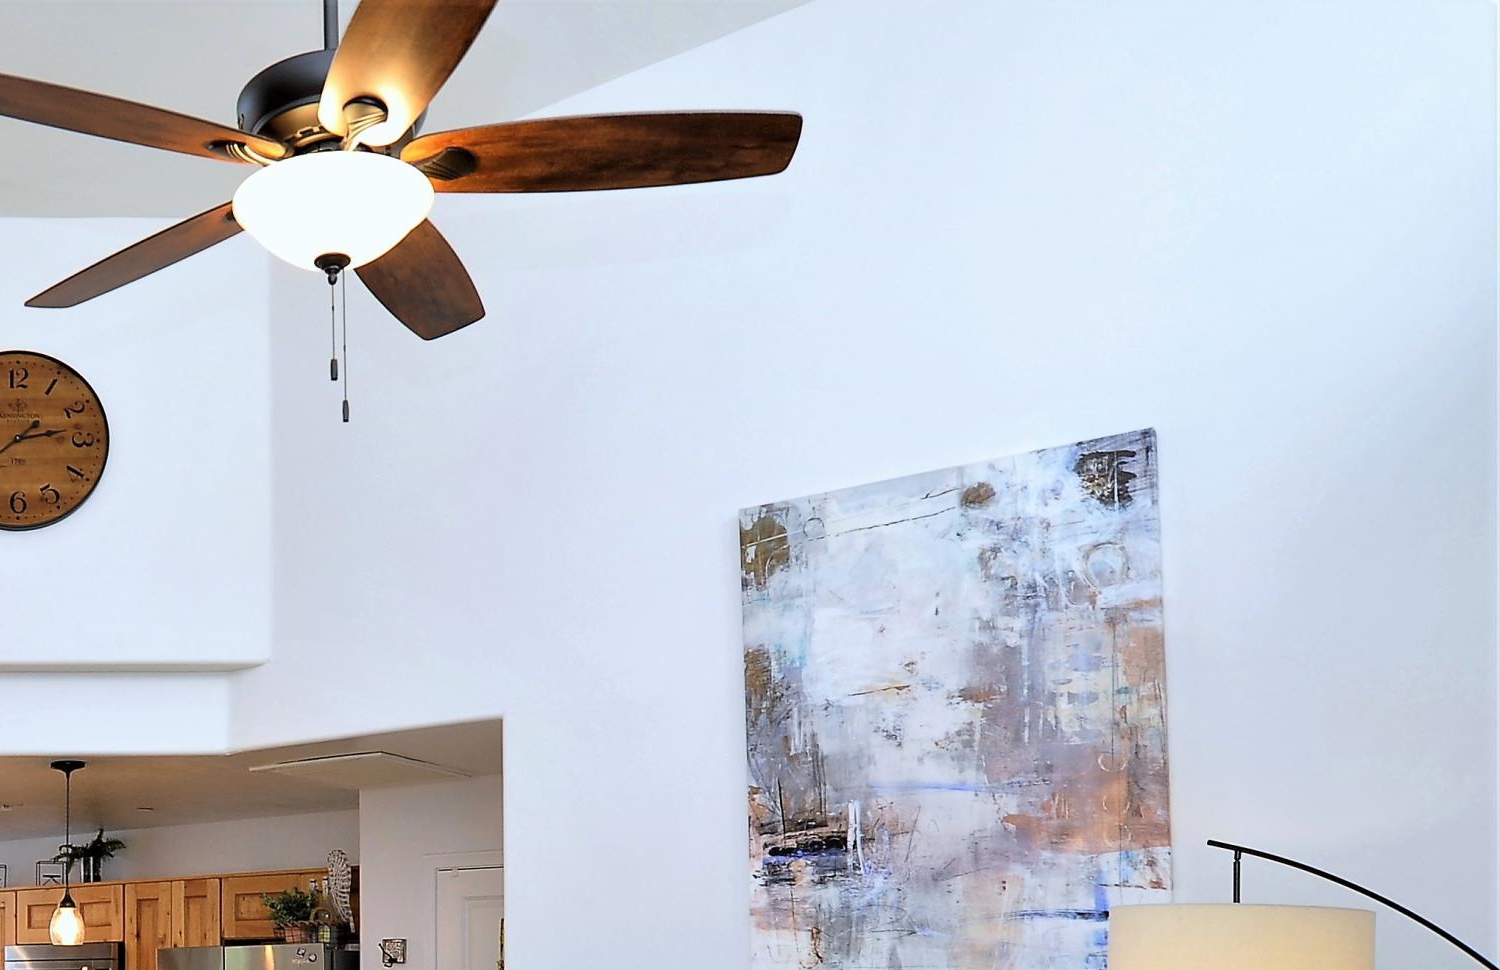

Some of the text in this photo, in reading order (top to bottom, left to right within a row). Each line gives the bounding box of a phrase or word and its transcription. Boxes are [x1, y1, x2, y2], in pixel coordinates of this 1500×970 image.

[9, 367, 29, 388] 12
[45, 378, 58, 395] 1
[63, 401, 85, 419] 2
[72, 431, 95, 448] 3
[10, 491, 27, 514] 6
[40, 484, 60, 505] 5
